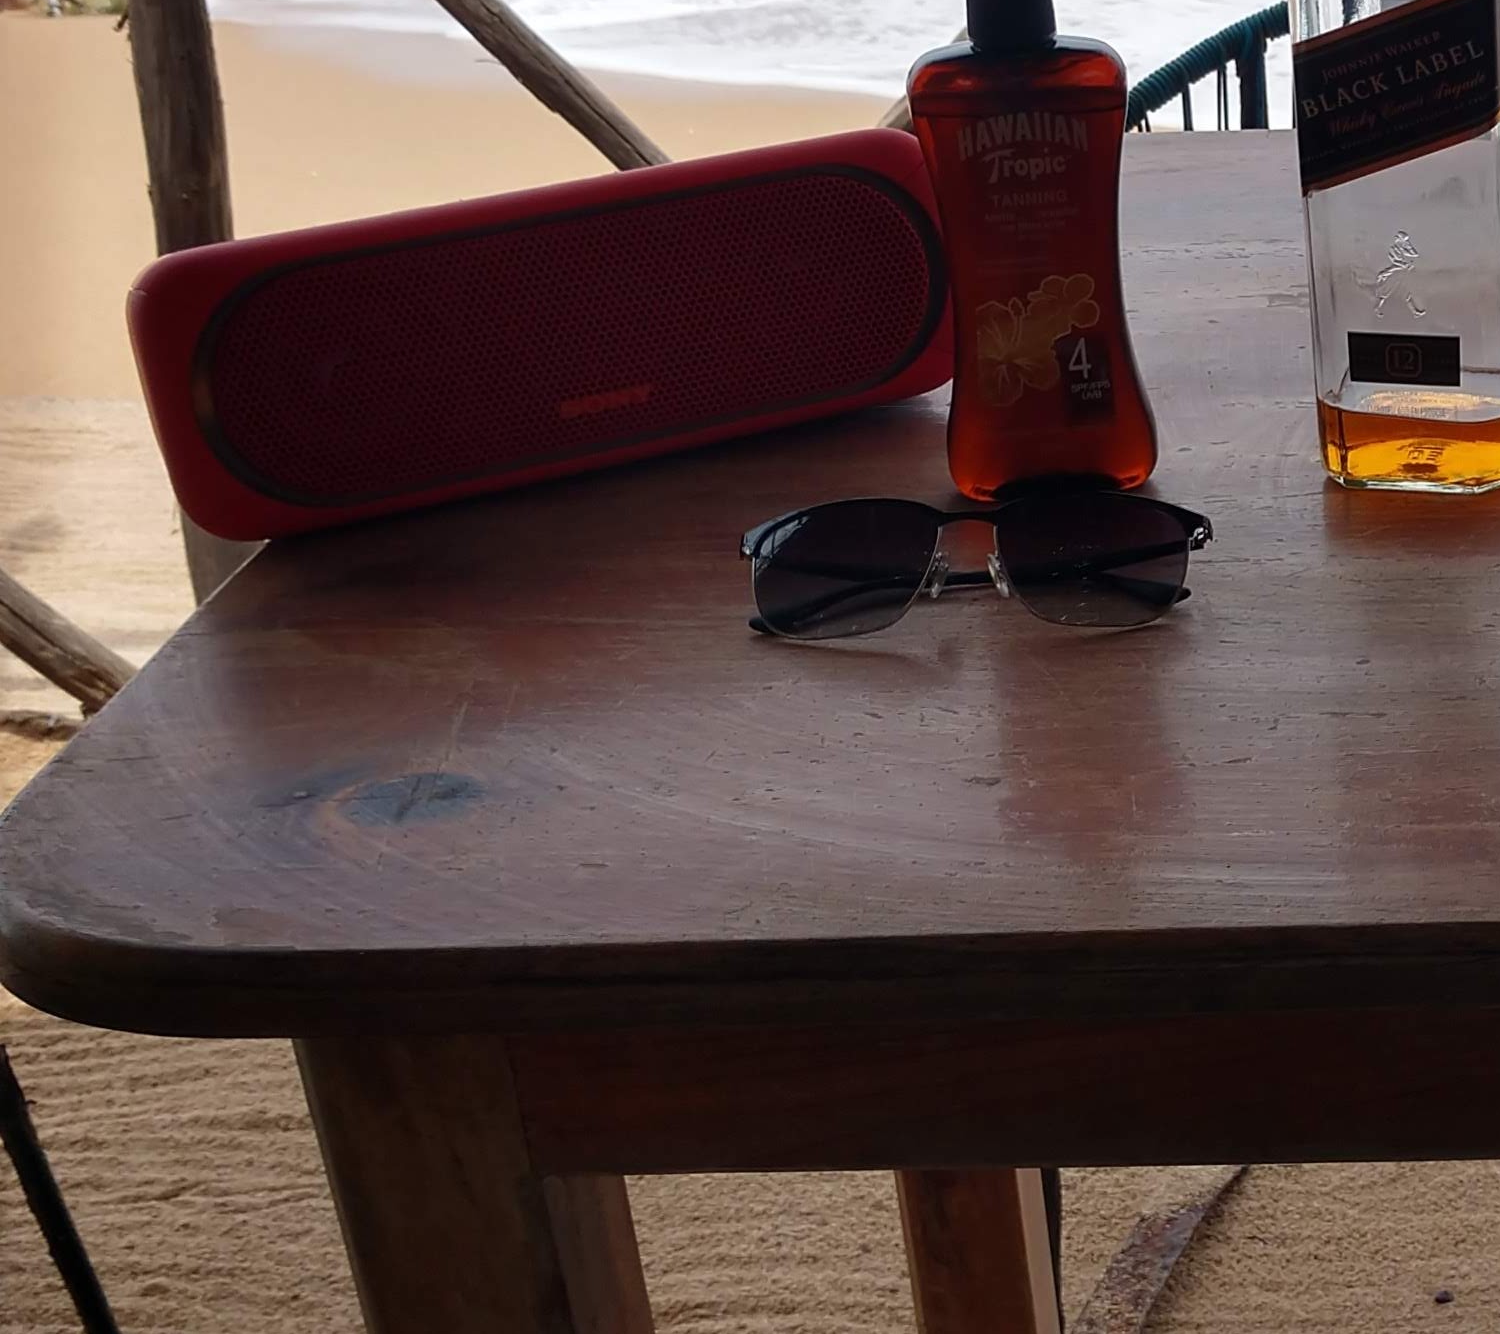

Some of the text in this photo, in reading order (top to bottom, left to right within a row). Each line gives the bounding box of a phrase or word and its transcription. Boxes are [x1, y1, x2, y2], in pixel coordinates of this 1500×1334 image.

[1321, 28, 1441, 84] JOHNNIE WALKER
[1300, 71, 1389, 119] BLACK
[1395, 39, 1484, 85] LABEL
[957, 111, 1088, 162] HAWAIIAN
[981, 147, 1067, 184] Tropic
[991, 189, 1068, 207] TANNING
[1068, 336, 1092, 379] 4
[1393, 349, 1416, 372] 12
